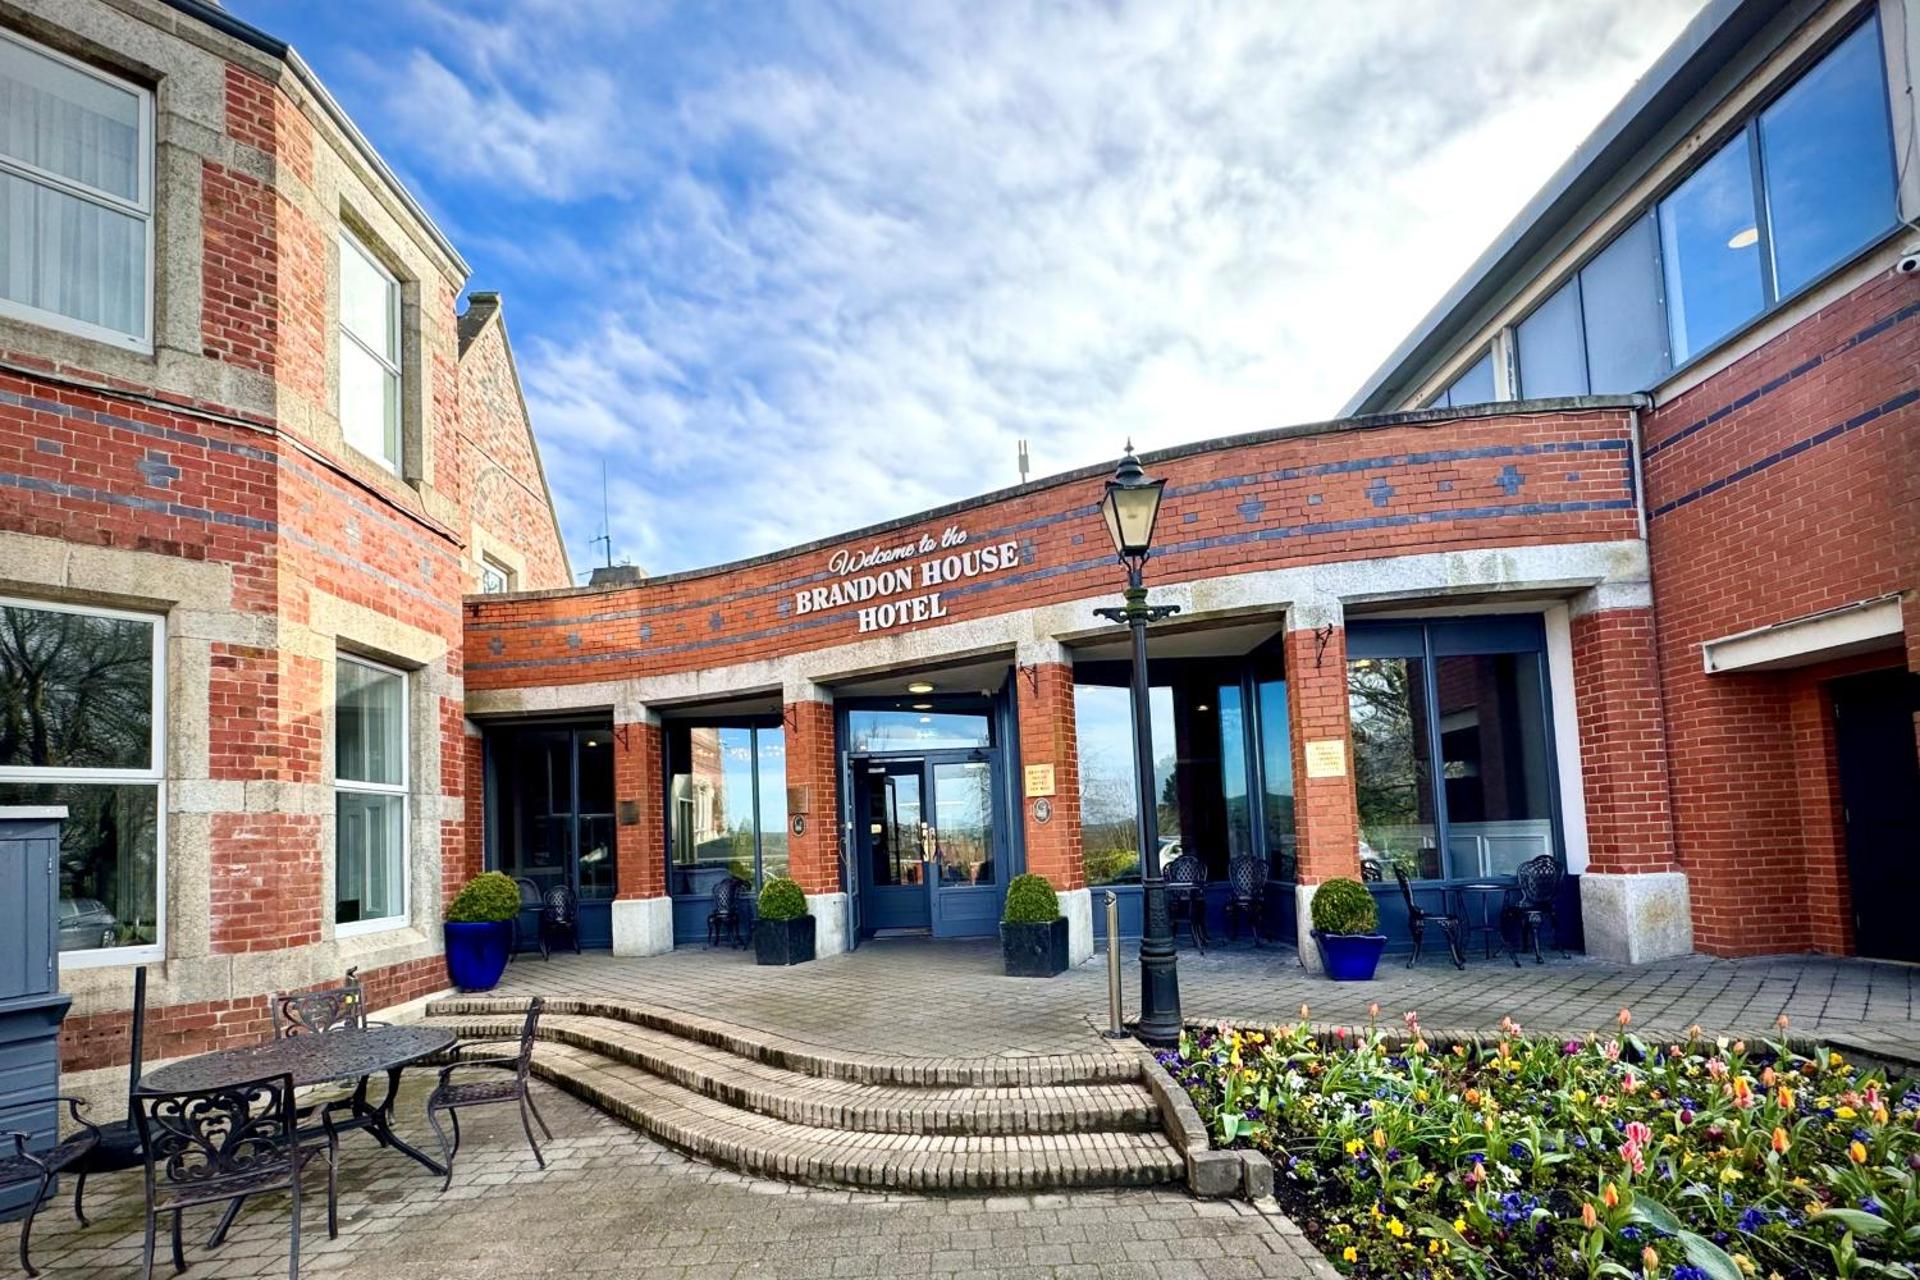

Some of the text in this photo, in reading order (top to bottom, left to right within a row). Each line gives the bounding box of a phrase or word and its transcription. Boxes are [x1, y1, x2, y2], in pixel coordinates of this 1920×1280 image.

[828, 525, 968, 576] Welcome to the
[795, 540, 1020, 615] BRANDON HOUSE
[858, 592, 947, 633] HOTEL
